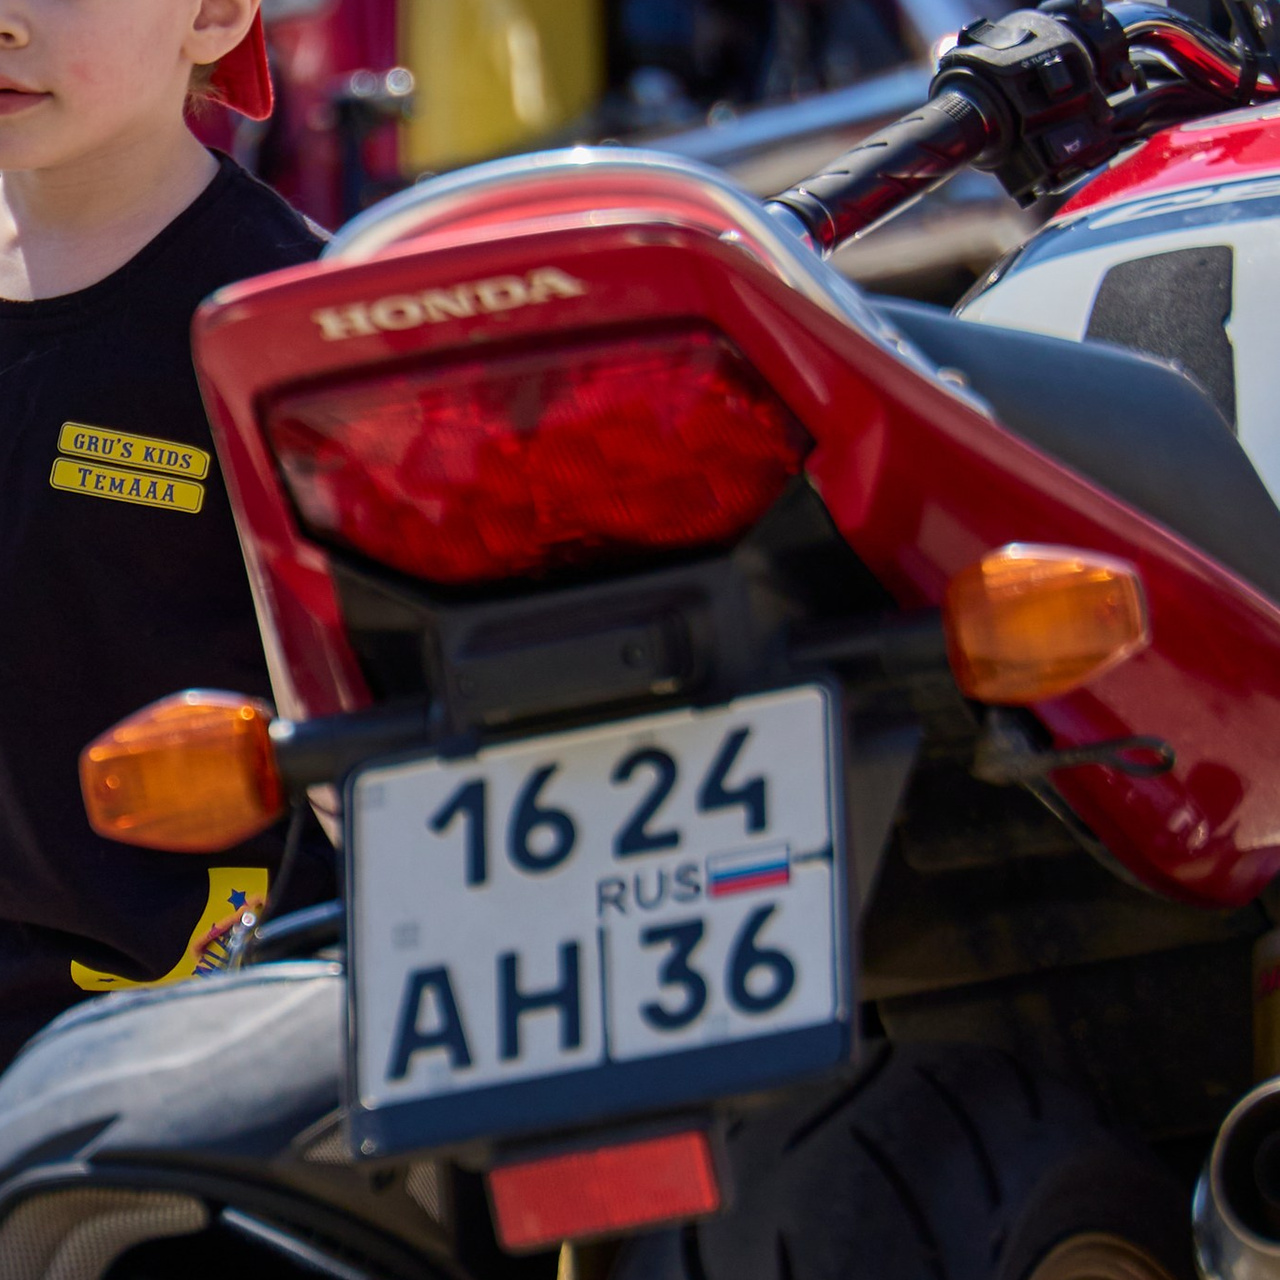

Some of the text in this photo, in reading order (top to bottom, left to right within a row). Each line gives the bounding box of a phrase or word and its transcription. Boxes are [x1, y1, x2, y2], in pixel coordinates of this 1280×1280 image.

[313, 266, 587, 341] HONDA
[73, 433, 193, 470] GRU'S KIDS
[596, 862, 702, 914] RUS
[638, 902, 797, 1032] 36
